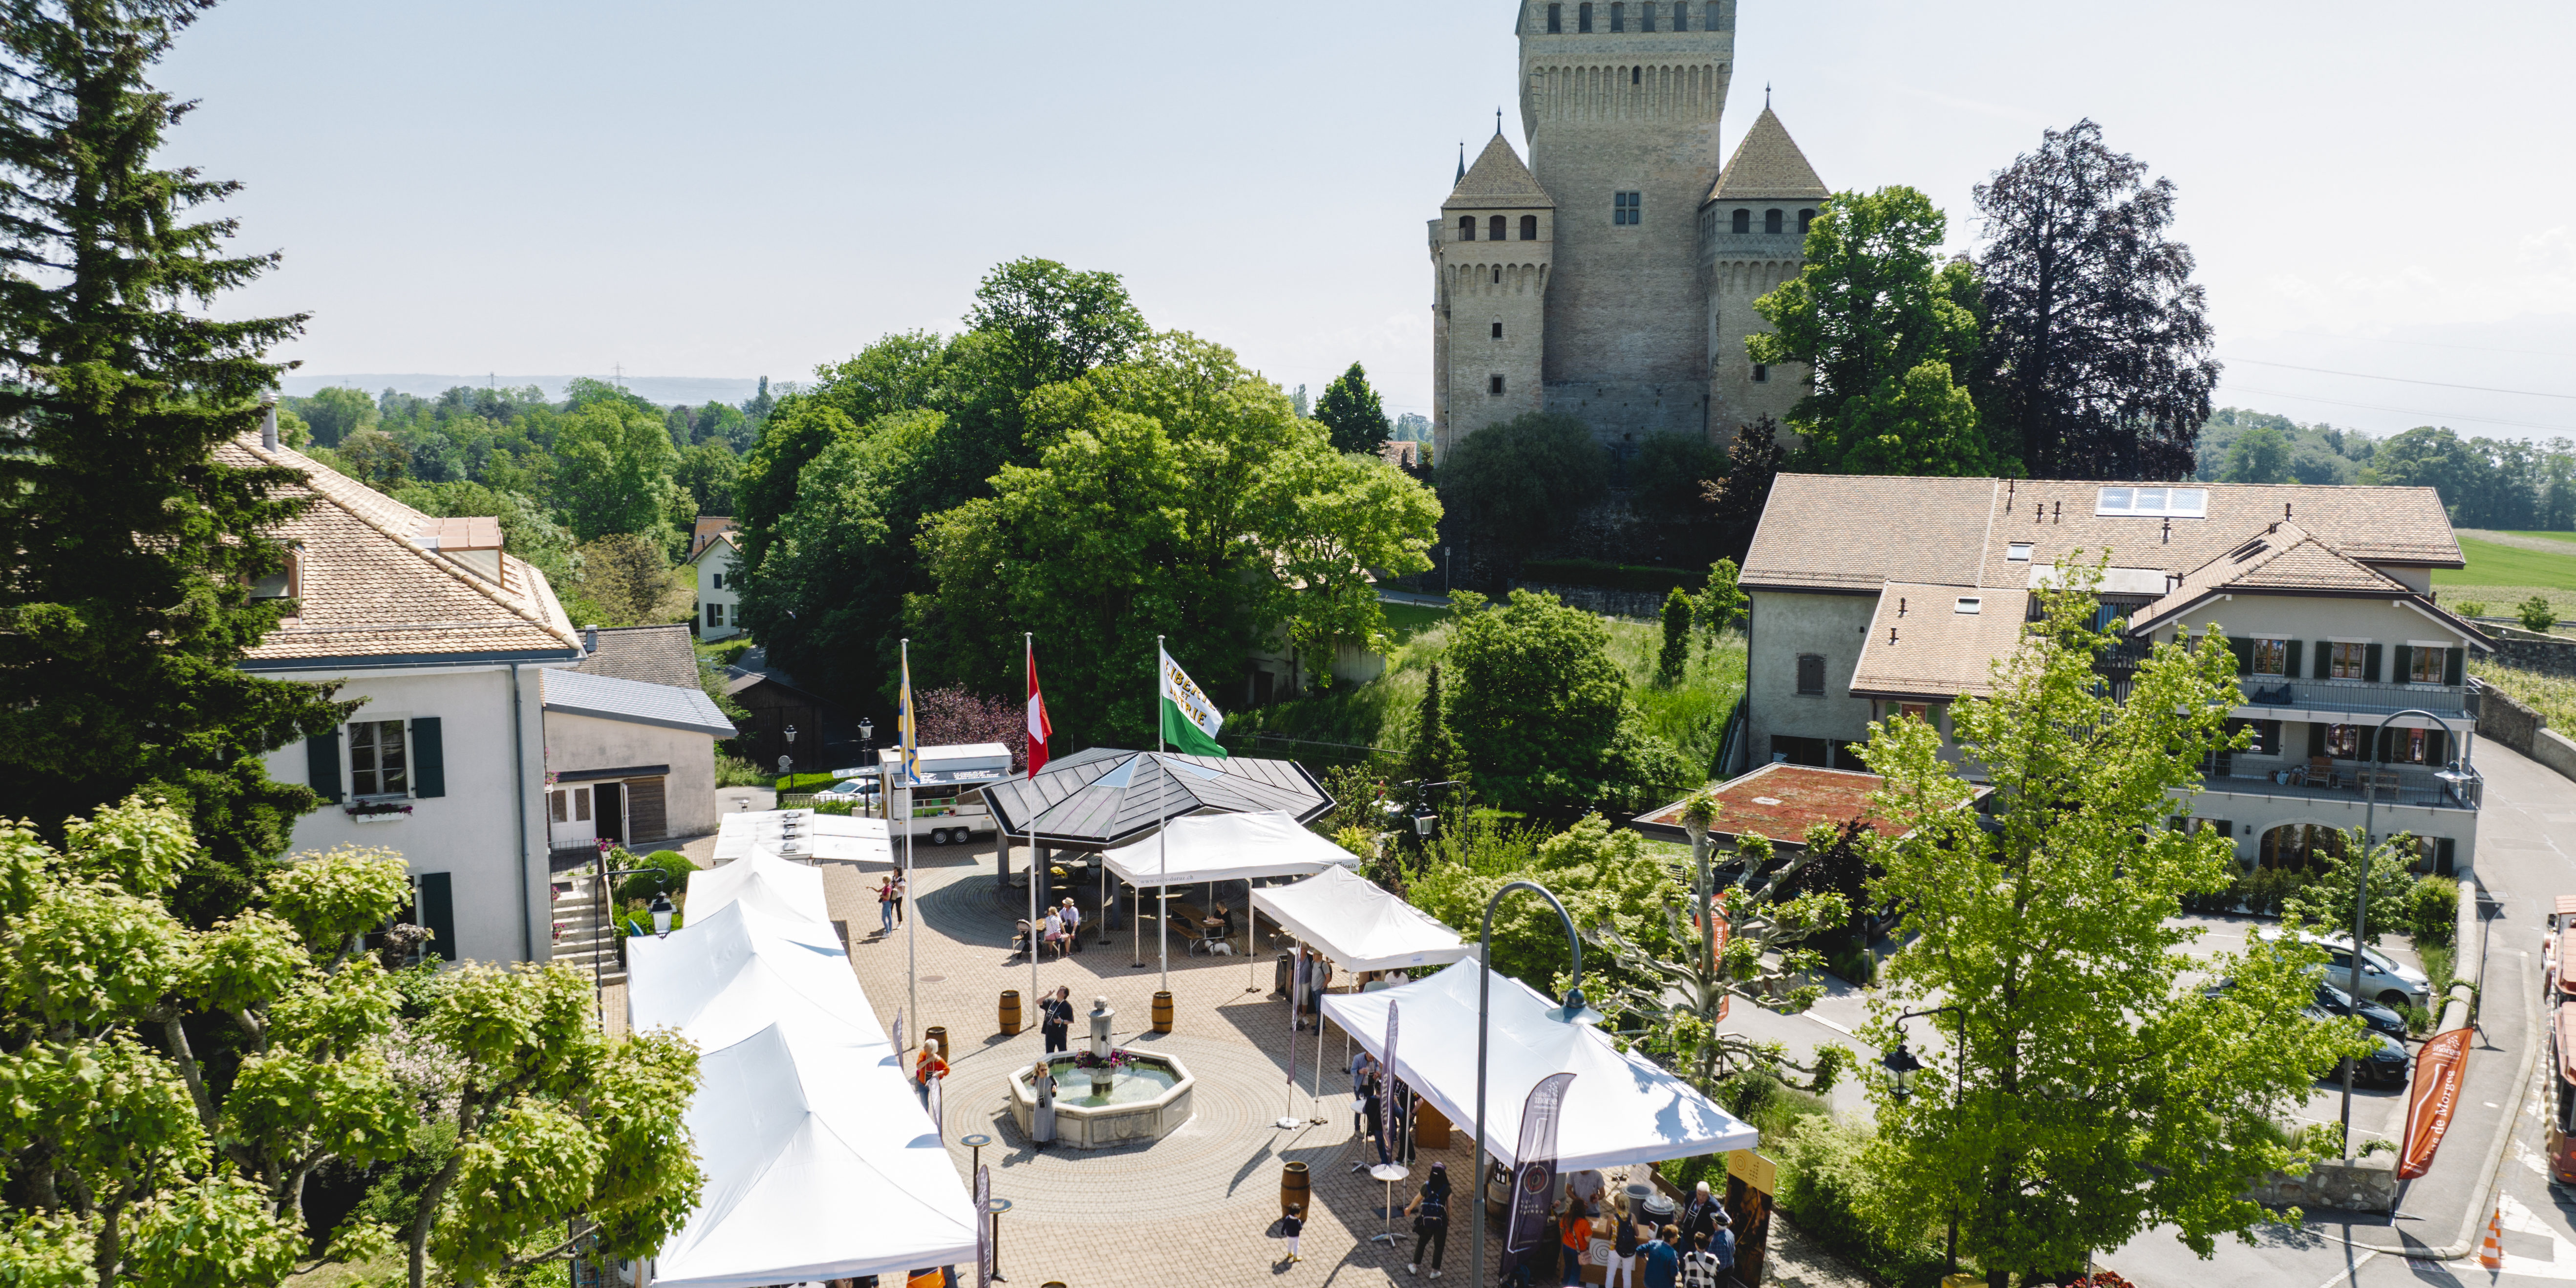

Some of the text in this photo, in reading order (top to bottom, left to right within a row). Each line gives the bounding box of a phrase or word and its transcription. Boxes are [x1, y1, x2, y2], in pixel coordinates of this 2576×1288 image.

[1181, 690, 1190, 700] ET
[1140, 875, 1193, 884] www.vis-duruz.ch
[2435, 1071, 2455, 1117] Morges
[2431, 1120, 2445, 1134] de
